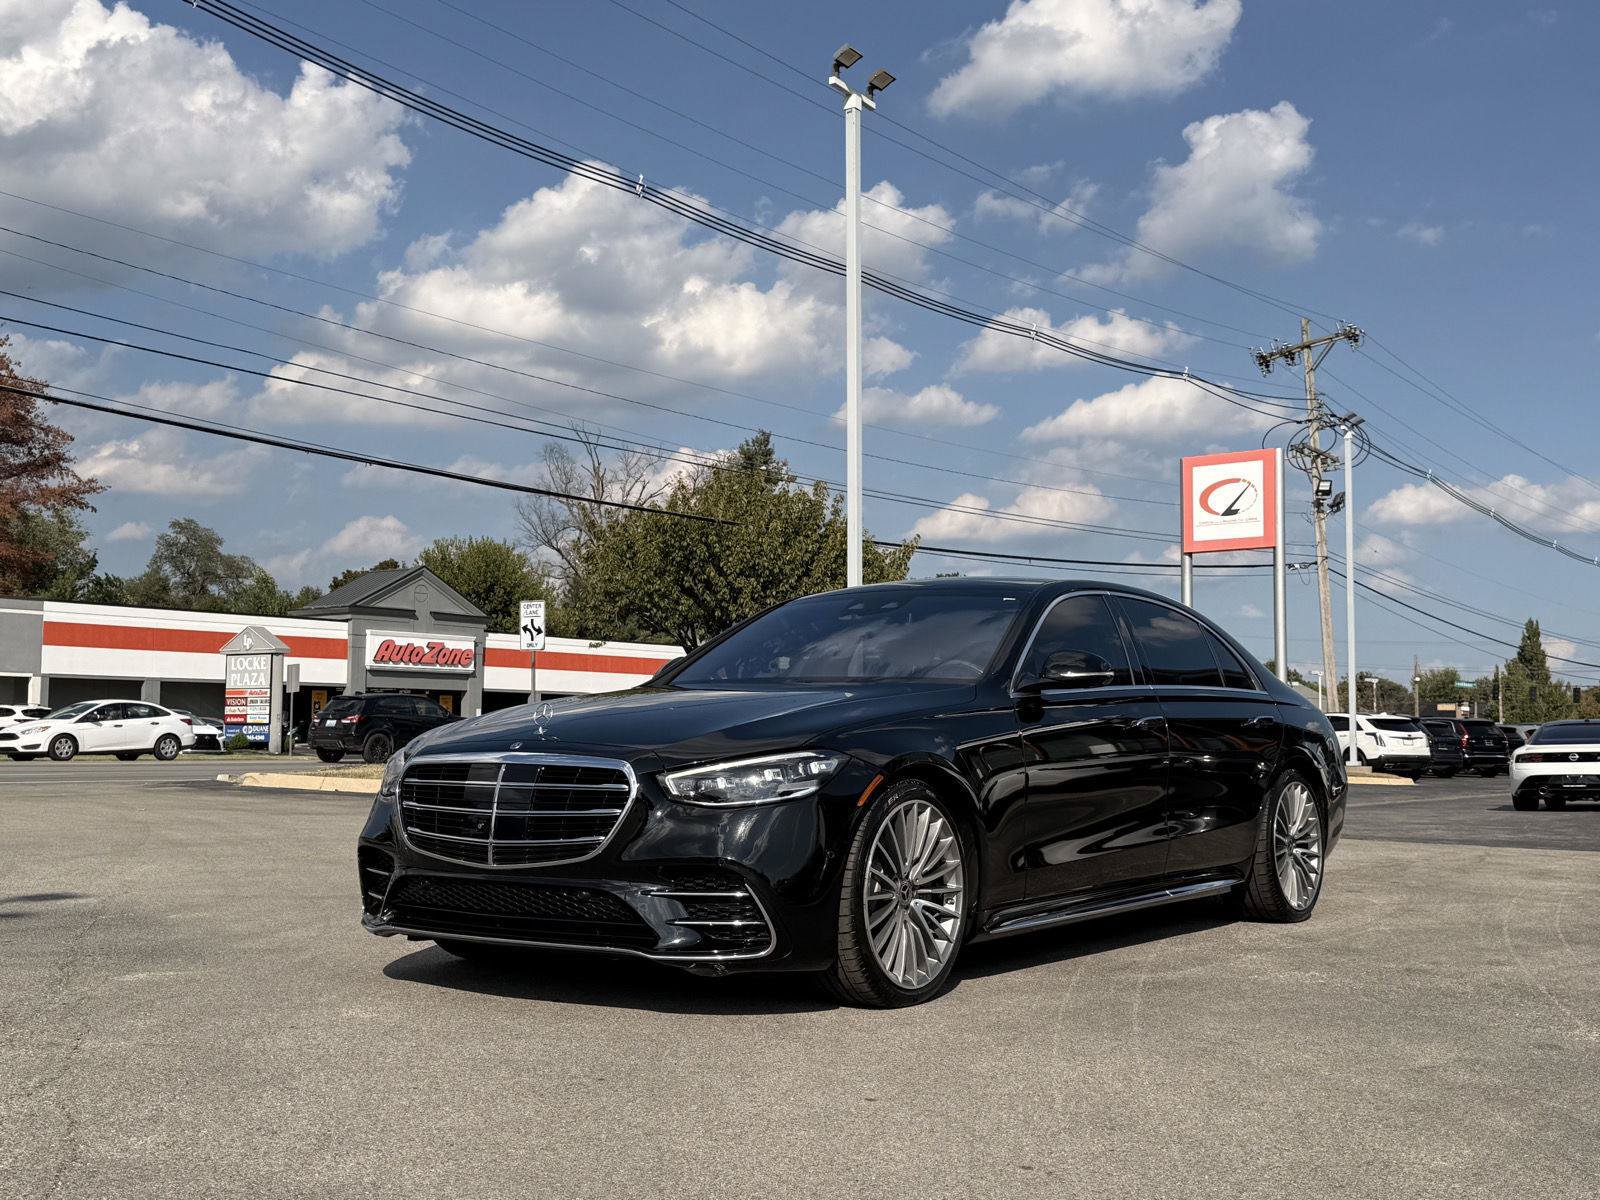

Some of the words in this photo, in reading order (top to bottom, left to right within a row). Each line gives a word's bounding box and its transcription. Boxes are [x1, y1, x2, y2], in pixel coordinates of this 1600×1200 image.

[373, 639, 473, 668] AutoZone
[231, 656, 267, 670] LOCKE
[230, 672, 266, 686] PLAZA
[226, 698, 247, 706] VISION
